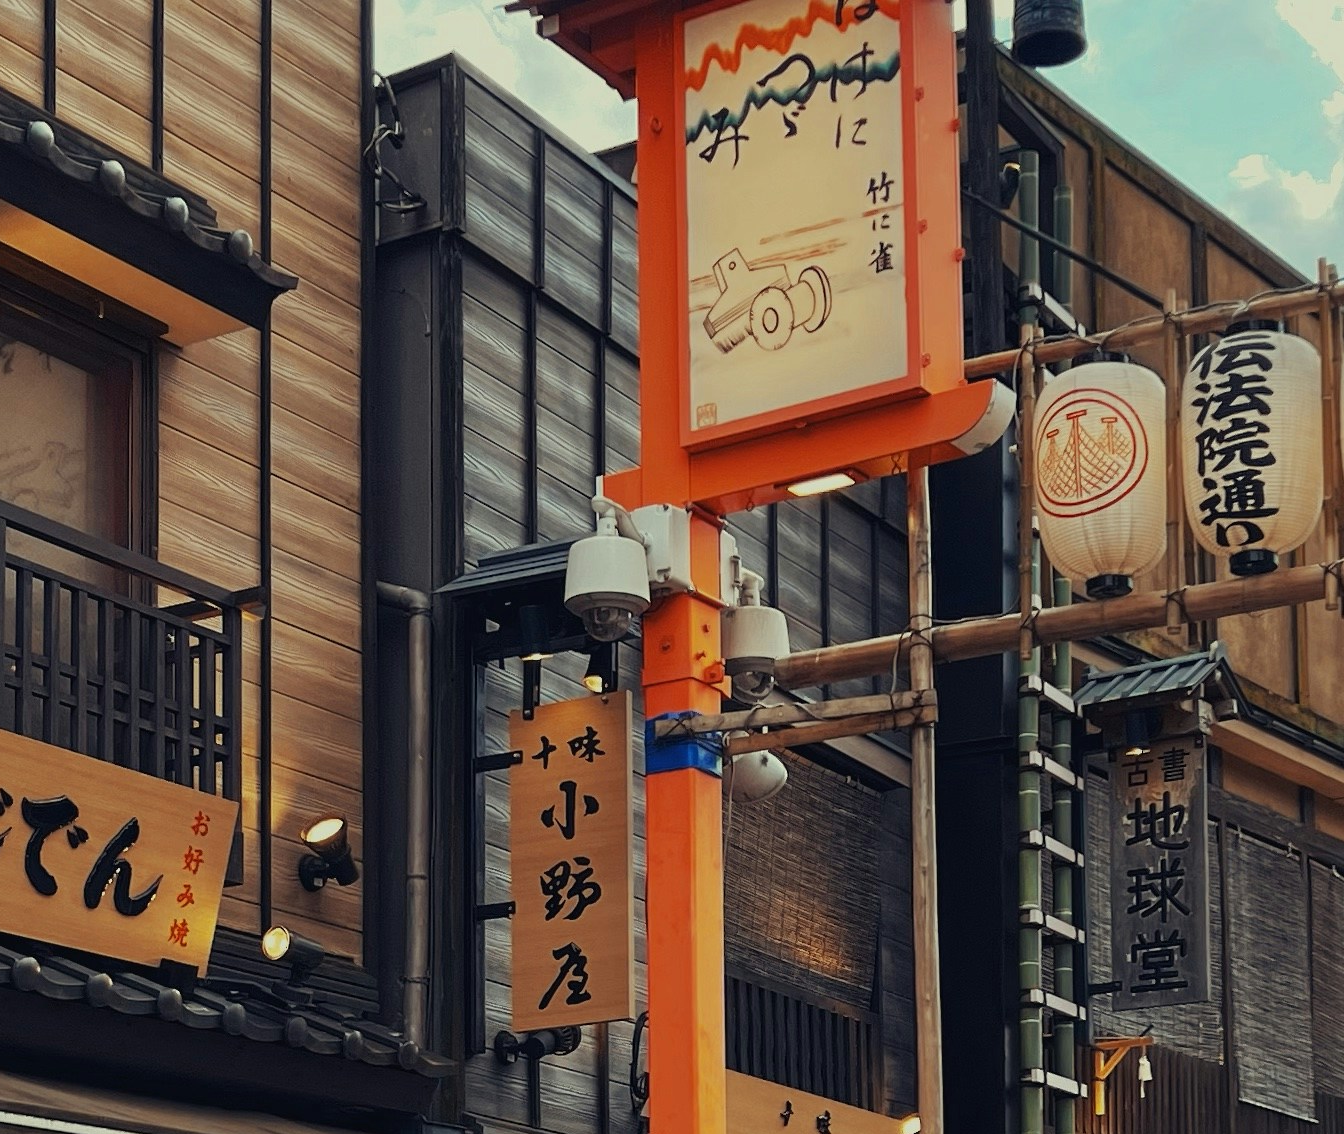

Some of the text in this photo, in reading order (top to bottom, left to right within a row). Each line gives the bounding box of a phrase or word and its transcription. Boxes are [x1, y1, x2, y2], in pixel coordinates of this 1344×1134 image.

[866, 172, 896, 274] 竹に雀
[1192, 332, 1279, 548] 伝法院通り
[531, 726, 606, 771] 十味
[167, 810, 211, 948] お好み焼
[538, 780, 602, 1010] 小野屋
[1126, 791, 1191, 994] 地球堂
